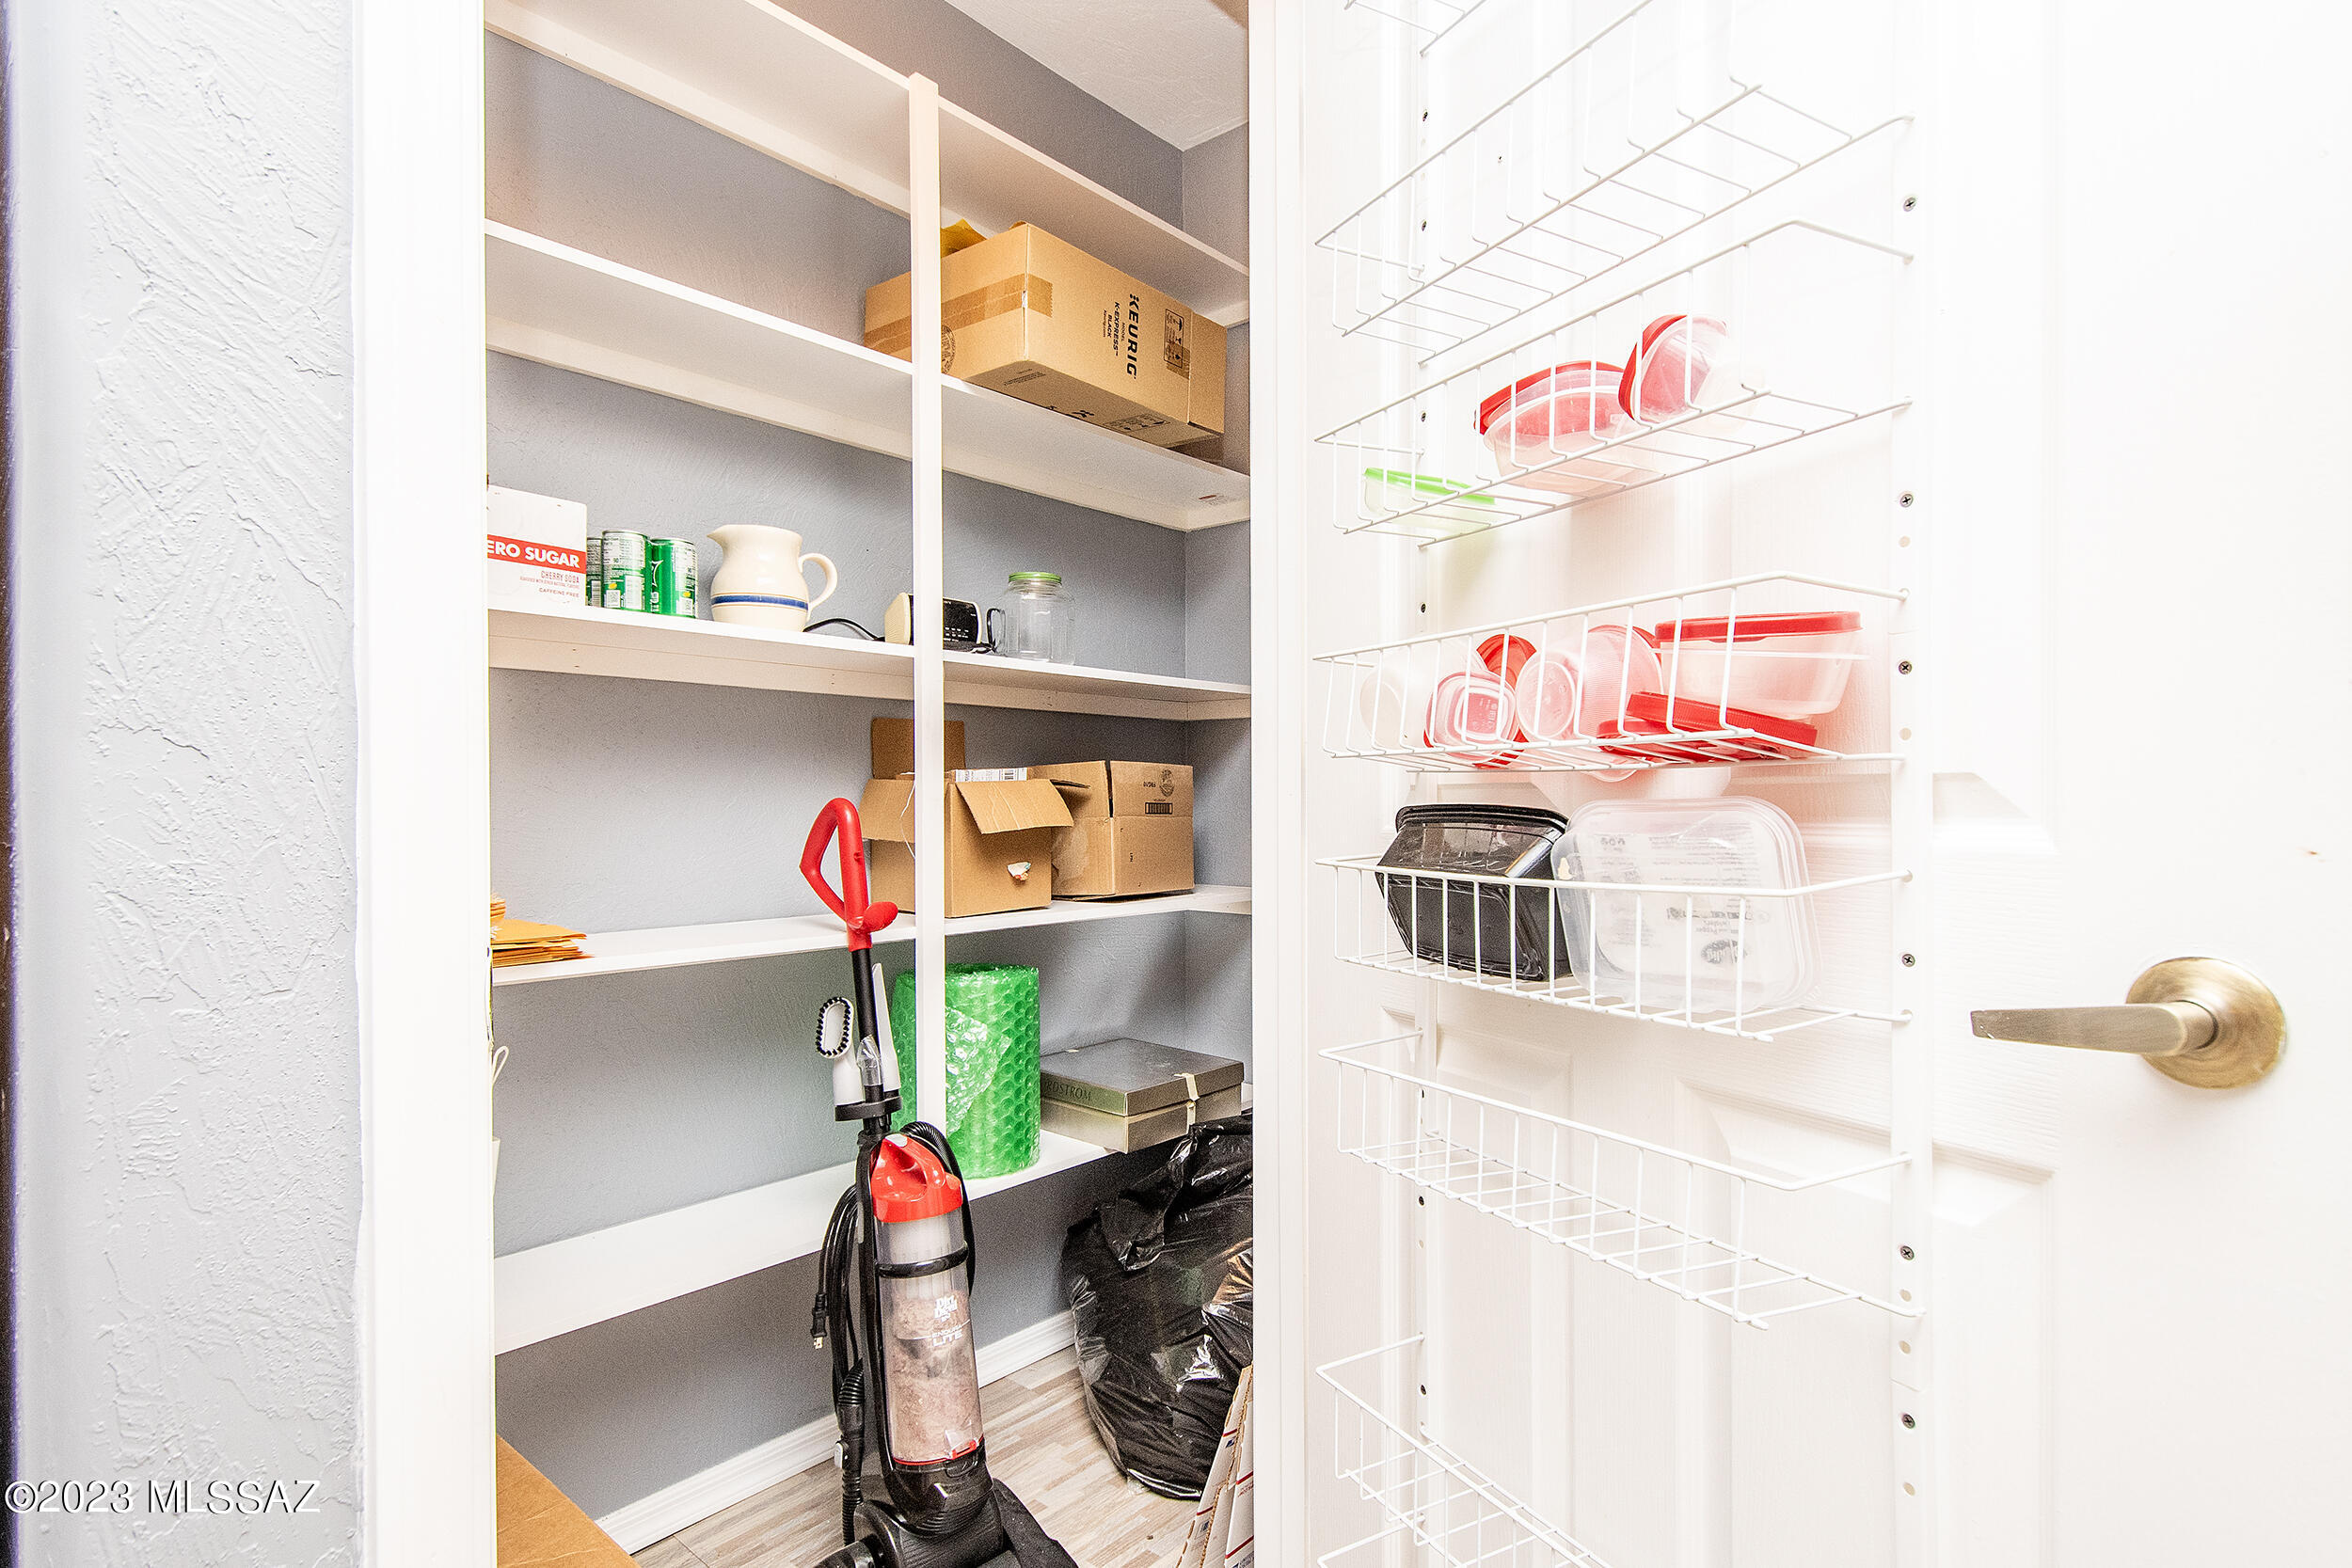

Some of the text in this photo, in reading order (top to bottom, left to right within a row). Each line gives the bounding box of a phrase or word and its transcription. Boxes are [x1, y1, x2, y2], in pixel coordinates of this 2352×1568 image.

[1126, 293, 1139, 377] KEURIG
[487, 539, 521, 558] ERO
[525, 546, 580, 568] SUGAR
[540, 570, 564, 581] CHERRY
[1043, 1080, 1091, 1101] RDSTROM
[932, 1329, 963, 1347] LITE
